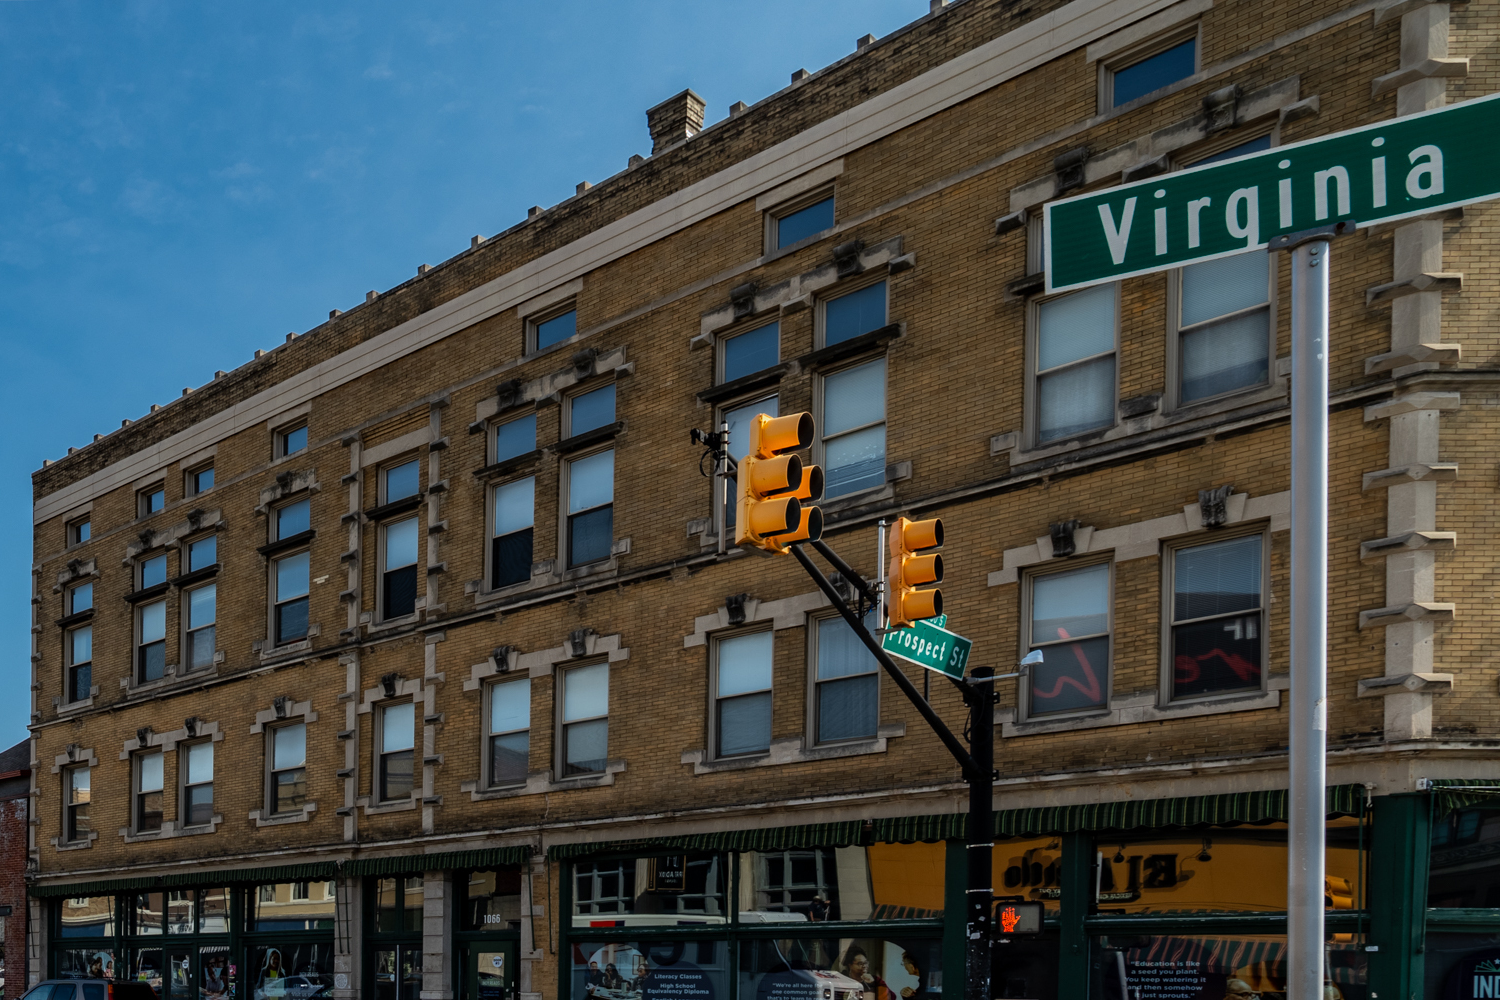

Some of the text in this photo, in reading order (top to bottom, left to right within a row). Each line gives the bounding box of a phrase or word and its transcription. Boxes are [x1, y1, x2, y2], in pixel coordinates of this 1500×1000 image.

[1098, 136, 1445, 265] Virginia
[889, 630, 964, 668] Prospect St
[484, 914, 500, 923] 1066
